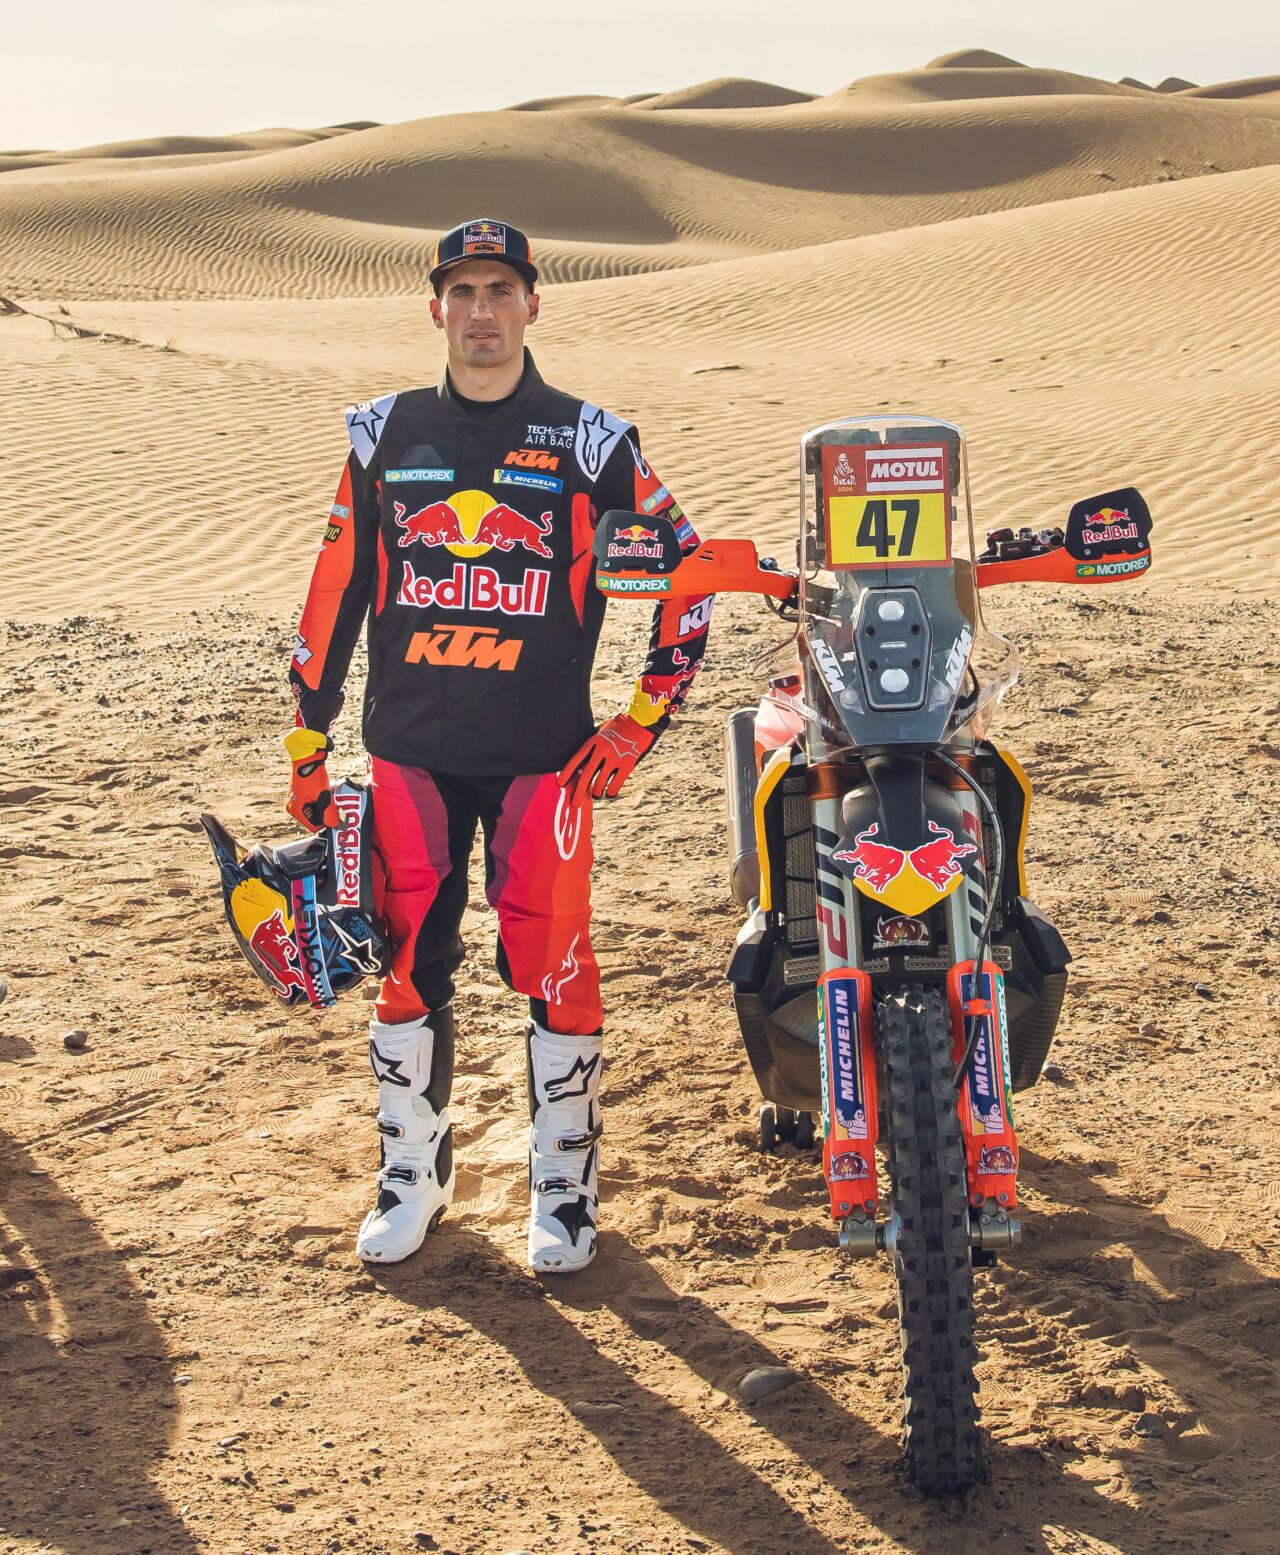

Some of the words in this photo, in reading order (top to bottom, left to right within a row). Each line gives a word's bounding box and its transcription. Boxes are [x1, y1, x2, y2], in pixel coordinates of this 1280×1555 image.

[525, 435, 546, 445] AIR
[550, 435, 572, 449] BAG
[503, 448, 560, 471] KTM
[871, 461, 939, 478] MOTUL
[401, 470, 451, 480] MOTOREX
[514, 475, 558, 488] MICHELIN
[856, 499, 920, 557] 47
[1082, 528, 1110, 544] Red
[1111, 523, 1138, 539] Bull
[608, 542, 635, 557] Red
[635, 543, 663, 558] Bull
[1096, 556, 1149, 575] MOTOREX
[397, 561, 466, 609] Red
[470, 566, 551, 616] Bull
[609, 579, 668, 590] MOTOREX
[404, 624, 524, 671] KTM
[945, 627, 973, 691] KTM
[810, 638, 845, 693] KTM
[334, 794, 361, 849] Bull
[336, 852, 360, 907] Red
[835, 988, 854, 1102] MICHELIN
